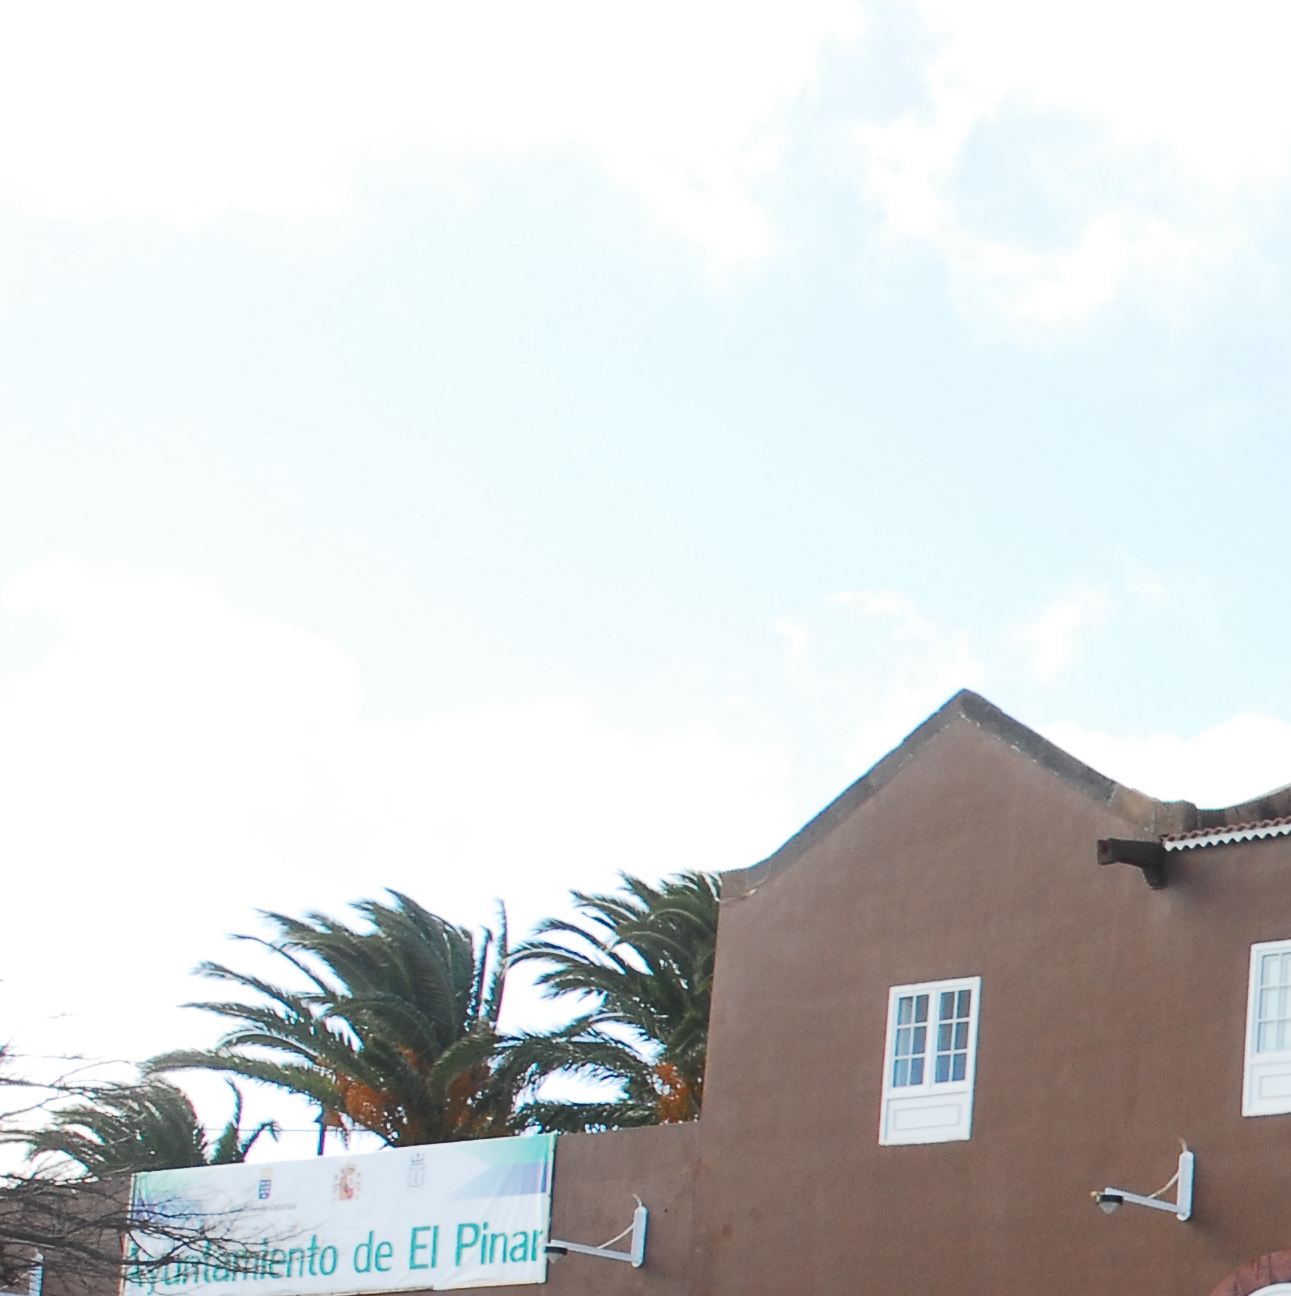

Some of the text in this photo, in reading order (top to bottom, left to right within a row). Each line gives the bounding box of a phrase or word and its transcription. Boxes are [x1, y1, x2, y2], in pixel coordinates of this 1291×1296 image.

[353, 1230, 393, 1274] de
[409, 1225, 440, 1271] El
[454, 1221, 545, 1267] Pinar
